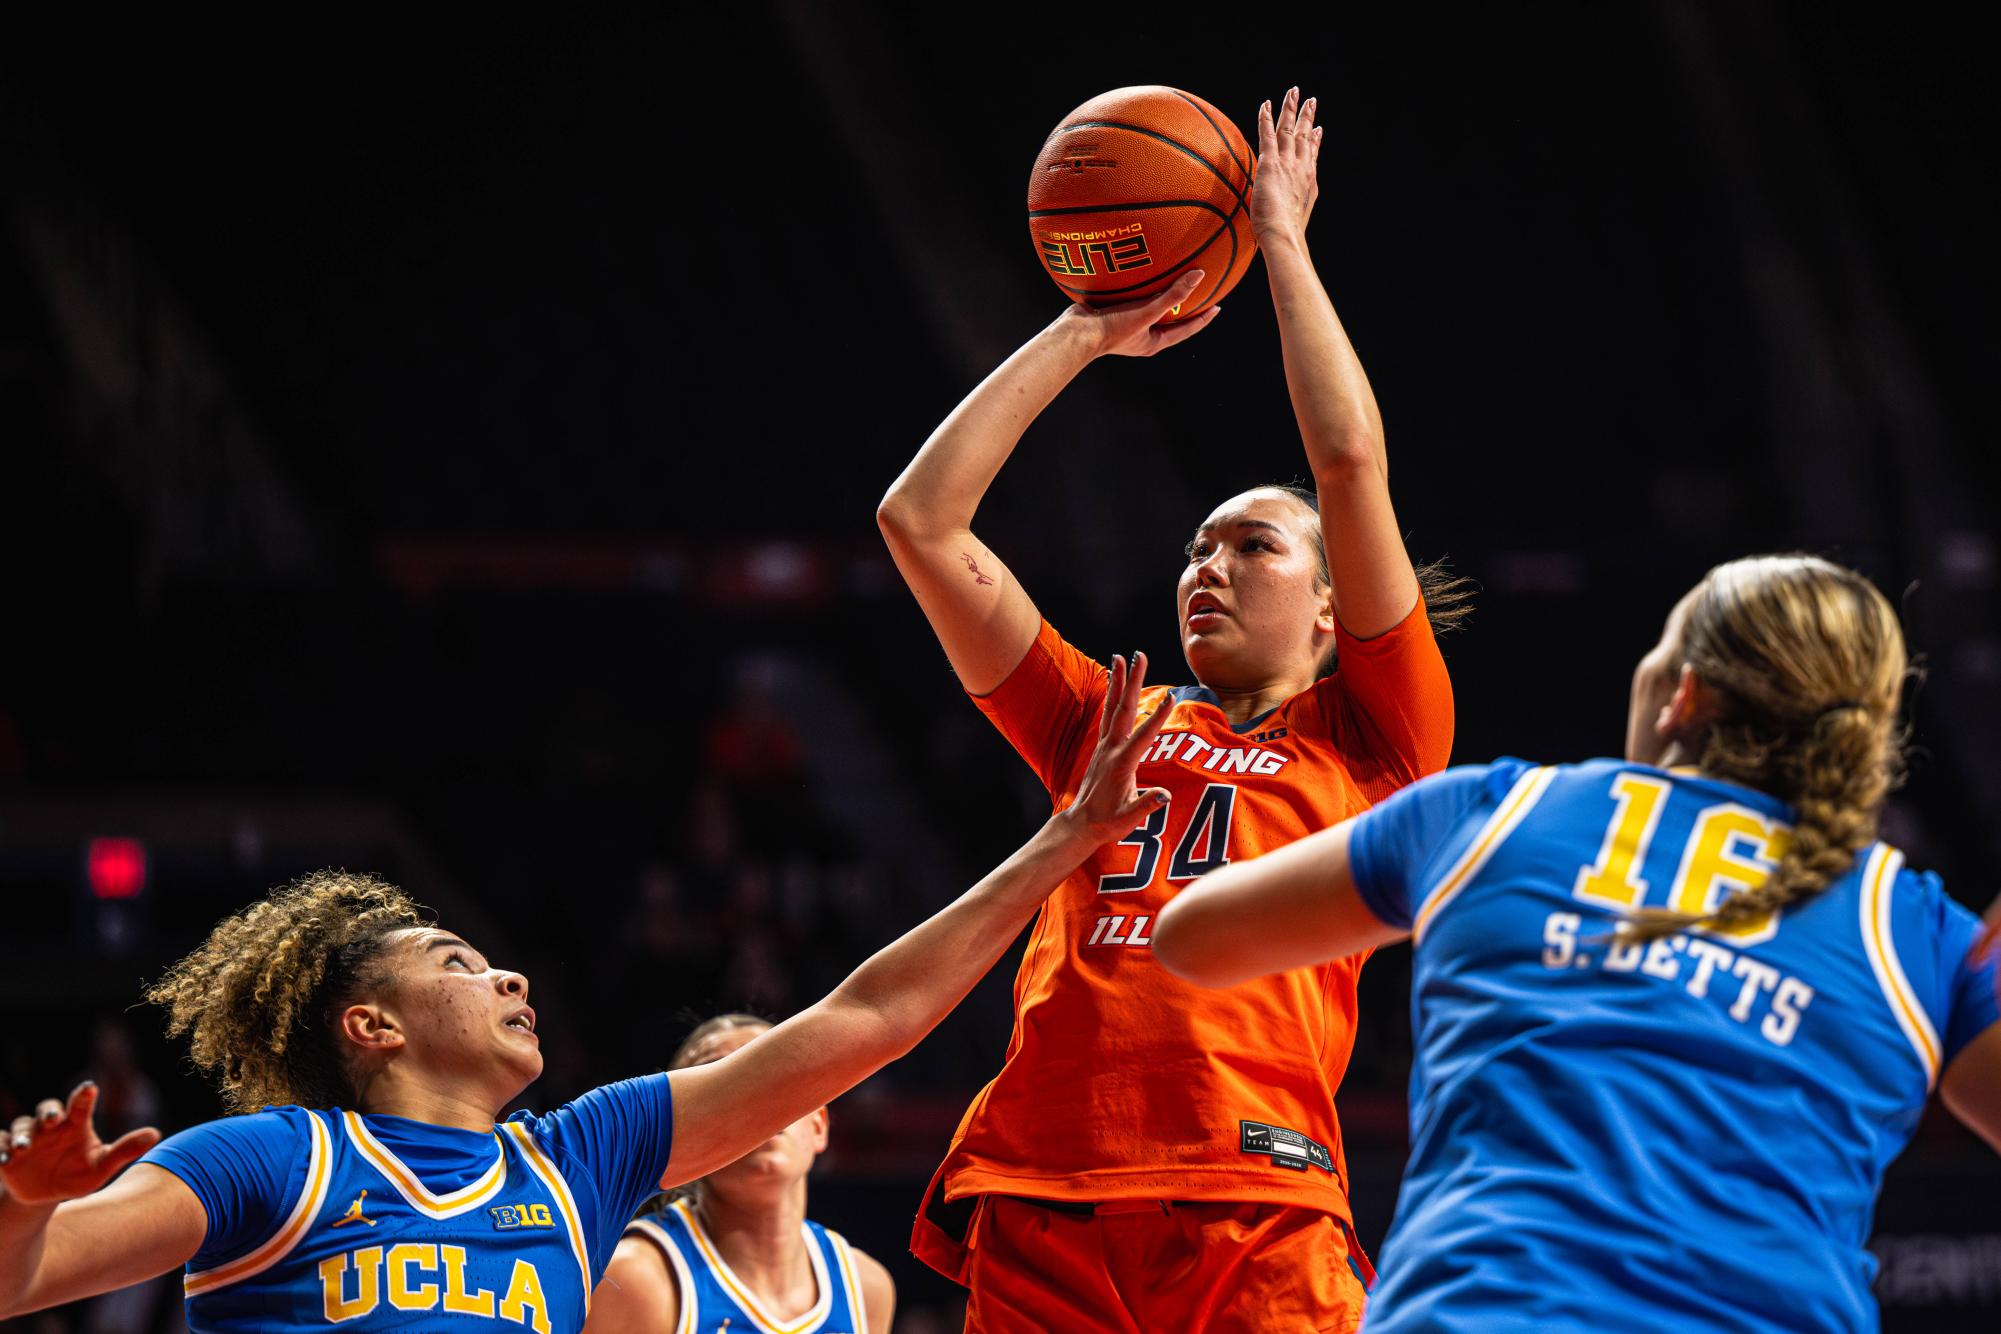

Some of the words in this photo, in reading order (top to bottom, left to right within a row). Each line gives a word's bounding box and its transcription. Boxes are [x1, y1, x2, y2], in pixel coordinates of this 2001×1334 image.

[1039, 232, 1153, 276] ELITE
[1040, 222, 1142, 241] CHAMPIONS
[1138, 731, 1290, 776] HTING
[1097, 782, 1238, 895] 34
[1571, 771, 1795, 948] 16
[1087, 915, 1154, 947] ILL
[1542, 911, 1592, 970] S.
[1247, 1139, 1271, 1147] TEAM
[318, 1242, 552, 1334] UCLA
